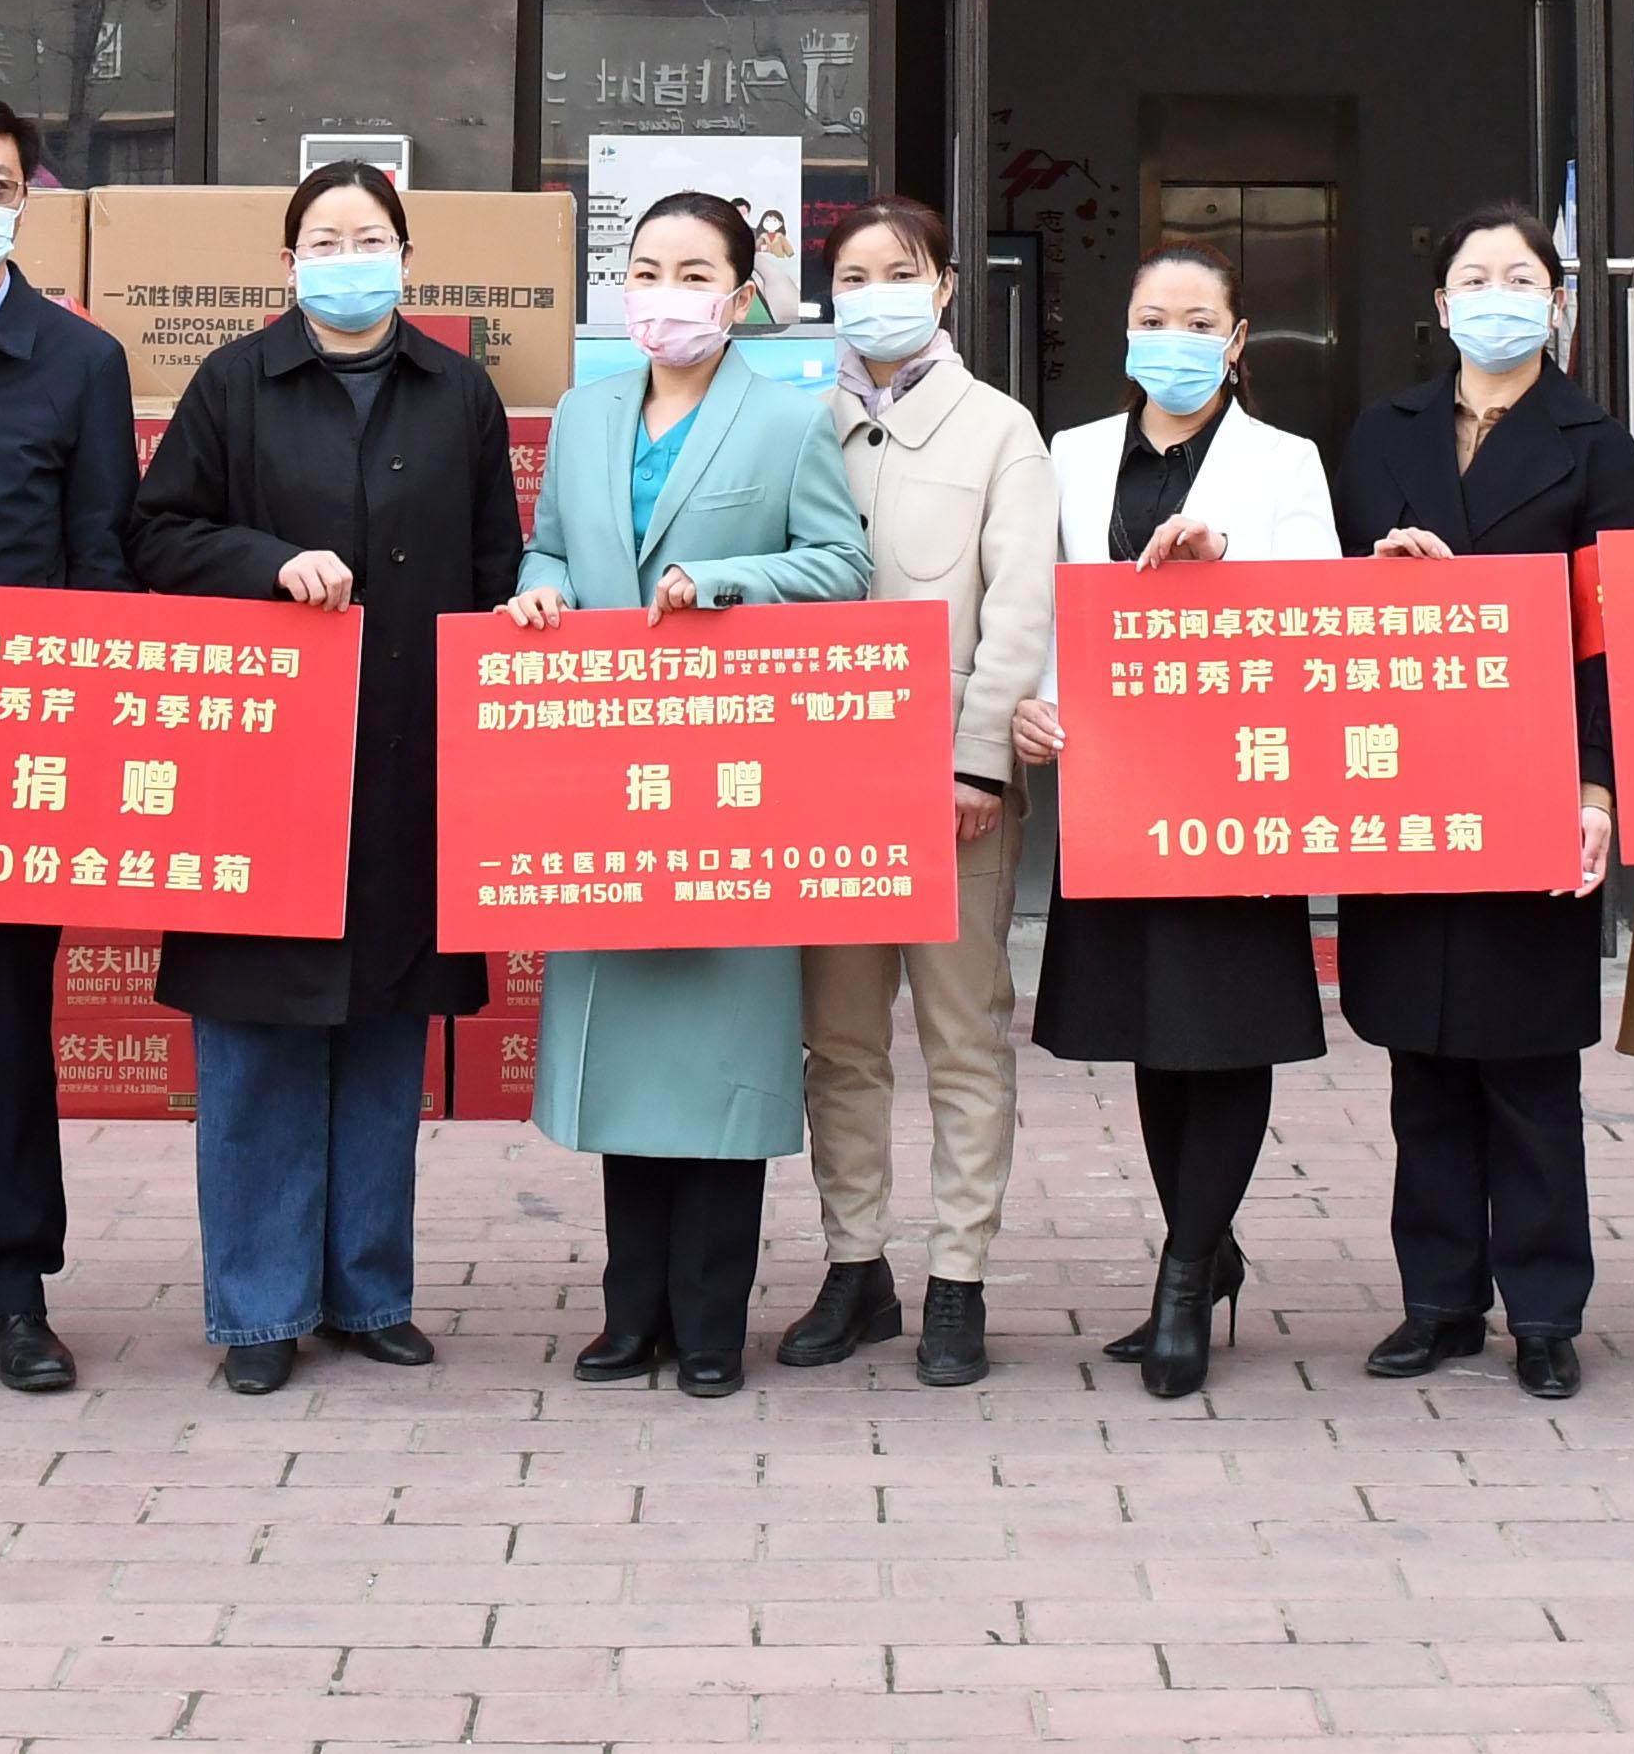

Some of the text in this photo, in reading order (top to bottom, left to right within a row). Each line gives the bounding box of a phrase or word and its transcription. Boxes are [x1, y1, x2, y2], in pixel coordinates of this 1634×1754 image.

[141, 332, 215, 346] MEDICAL
[154, 317, 255, 332] DISPOSABLE
[1113, 603, 1510, 641] 江苏闽卓农业发展有限公司
[477, 643, 910, 686] 疫情攻坚见行动 朱华林
[1153, 655, 1511, 695] 胡秀芹 为绿地社区
[112, 691, 277, 733] 为季桥村
[1147, 812, 1484, 856] 100份金丝皇菊
[479, 844, 911, 876] 一次性医用外科口罩10000只
[477, 875, 913, 907] 免洗洗手液150瓶 测温仪5台 方便面20箱
[67, 977, 121, 992] NONGFU
[58, 1033, 169, 1063] 农夫山泉
[58, 1065, 168, 1080] NONGFU SPRING
